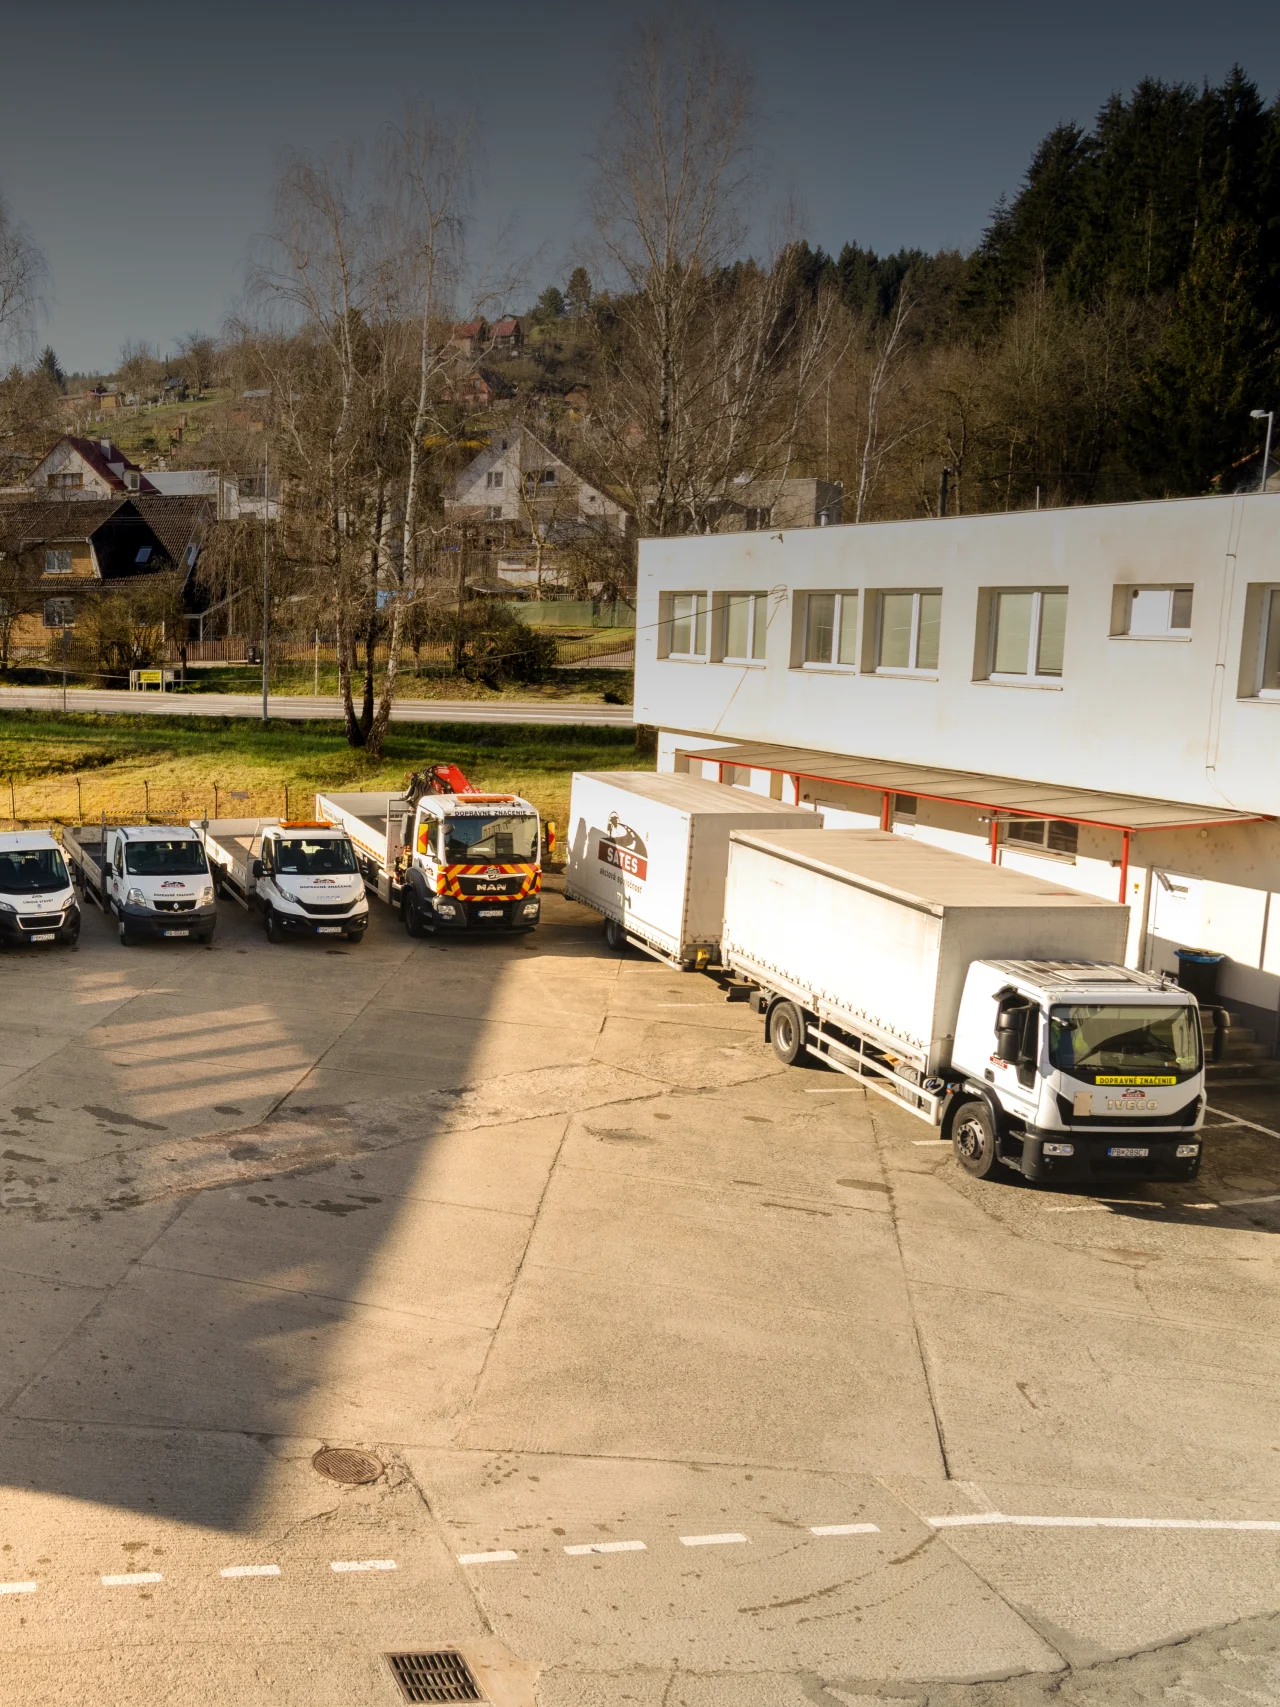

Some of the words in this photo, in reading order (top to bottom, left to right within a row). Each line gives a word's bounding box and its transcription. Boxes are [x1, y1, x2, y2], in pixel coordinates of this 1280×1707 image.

[607, 847, 638, 874] SATES
[1100, 1076, 1137, 1084] DOPRAVNÉ
[1140, 1076, 1173, 1084] ZNAČENIE
[1107, 1100, 1158, 1110] IVECO
